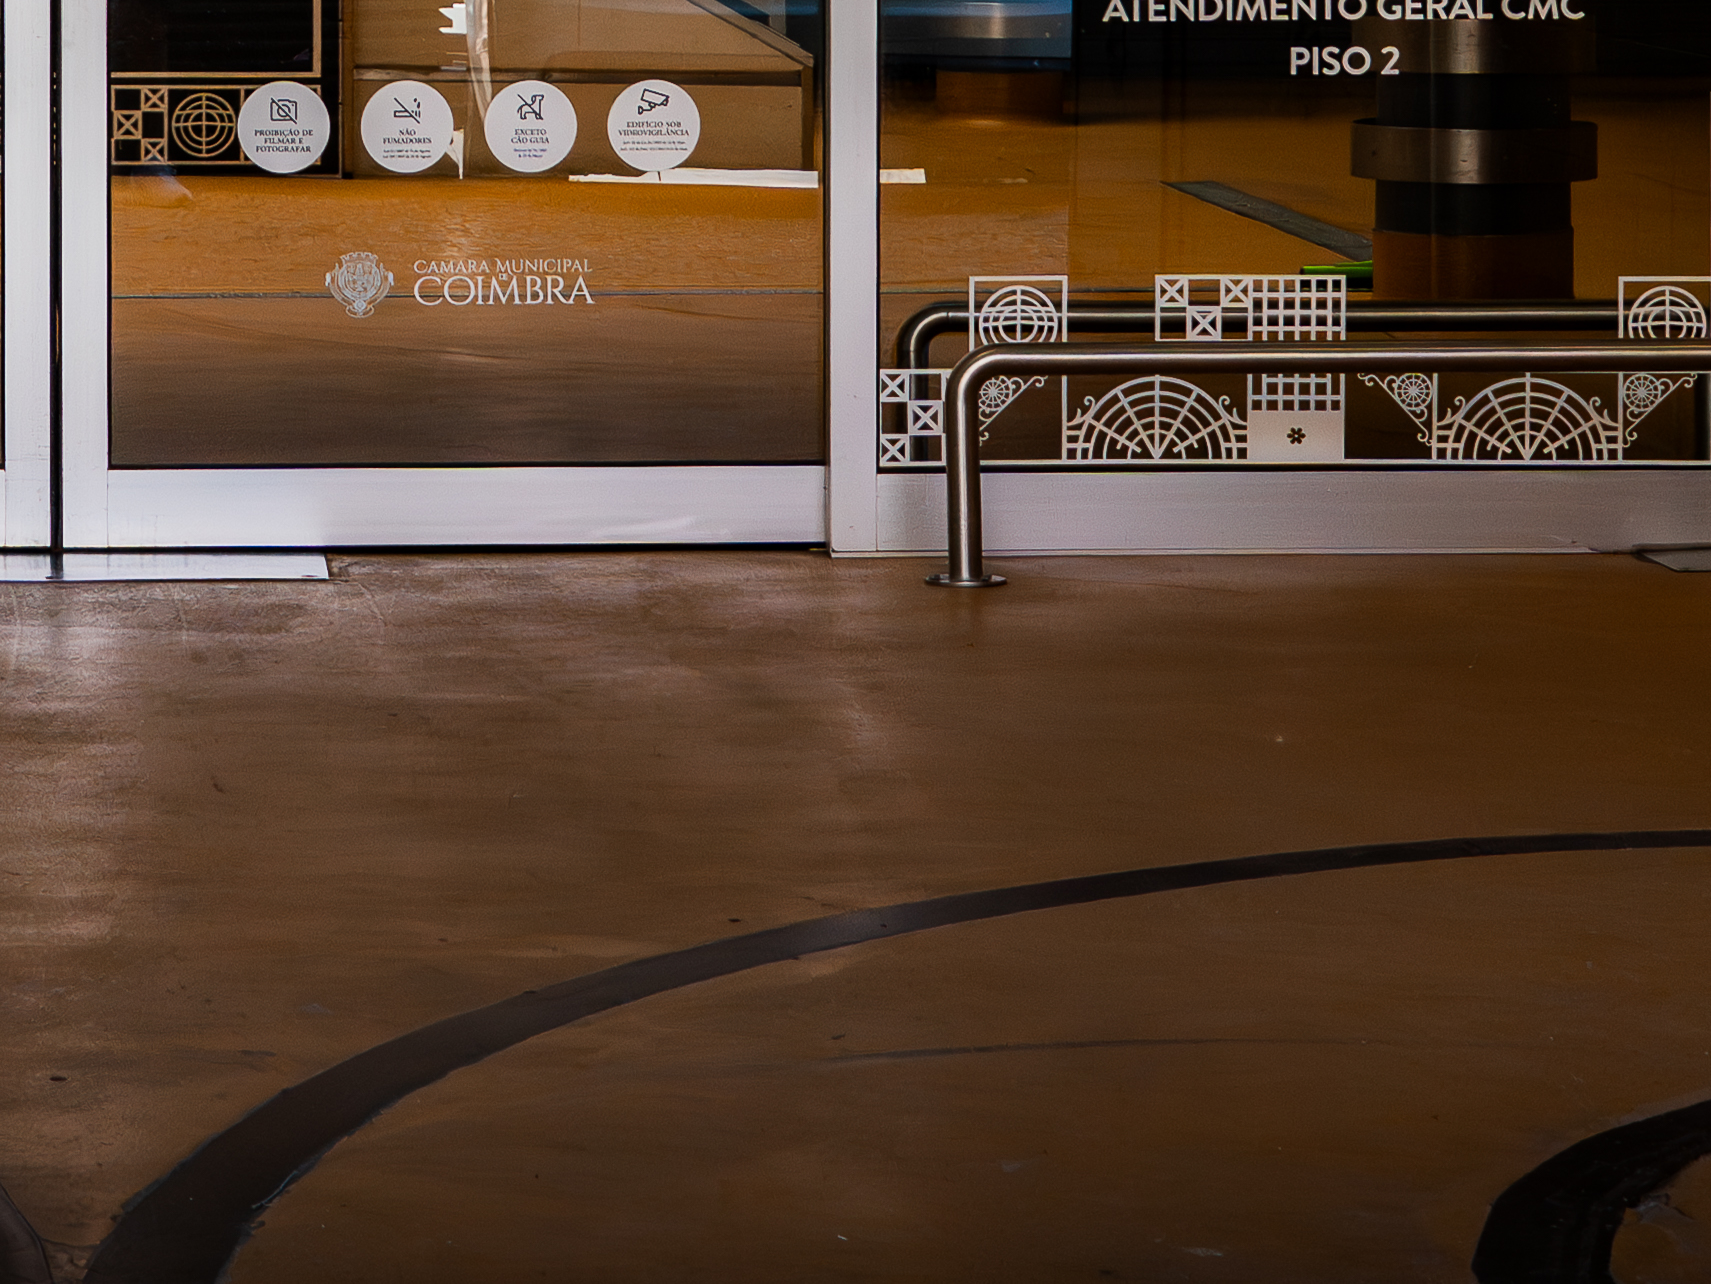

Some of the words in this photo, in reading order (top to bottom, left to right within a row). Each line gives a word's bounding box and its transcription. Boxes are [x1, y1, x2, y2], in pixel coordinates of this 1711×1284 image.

[1290, 45, 1372, 76] PISO
[1380, 45, 1400, 75] 2
[626, 119, 664, 129] EDIFÍCIO
[666, 121, 682, 129] SOB
[254, 127, 300, 139] PROIBIÇÃO
[302, 129, 314, 137] DE
[399, 127, 417, 137] NÃO
[514, 128, 547, 136] EXCETO
[264, 136, 296, 145] FILMAR
[298, 137, 303, 145] E
[382, 137, 432, 145] FUMADORES
[510, 135, 528, 144] CÃO
[529, 136, 550, 144] GUIA
[255, 145, 311, 153] FOTOGRAFAR
[495, 257, 594, 275] MUNICIPAL
[413, 275, 596, 306] COIMBRA
